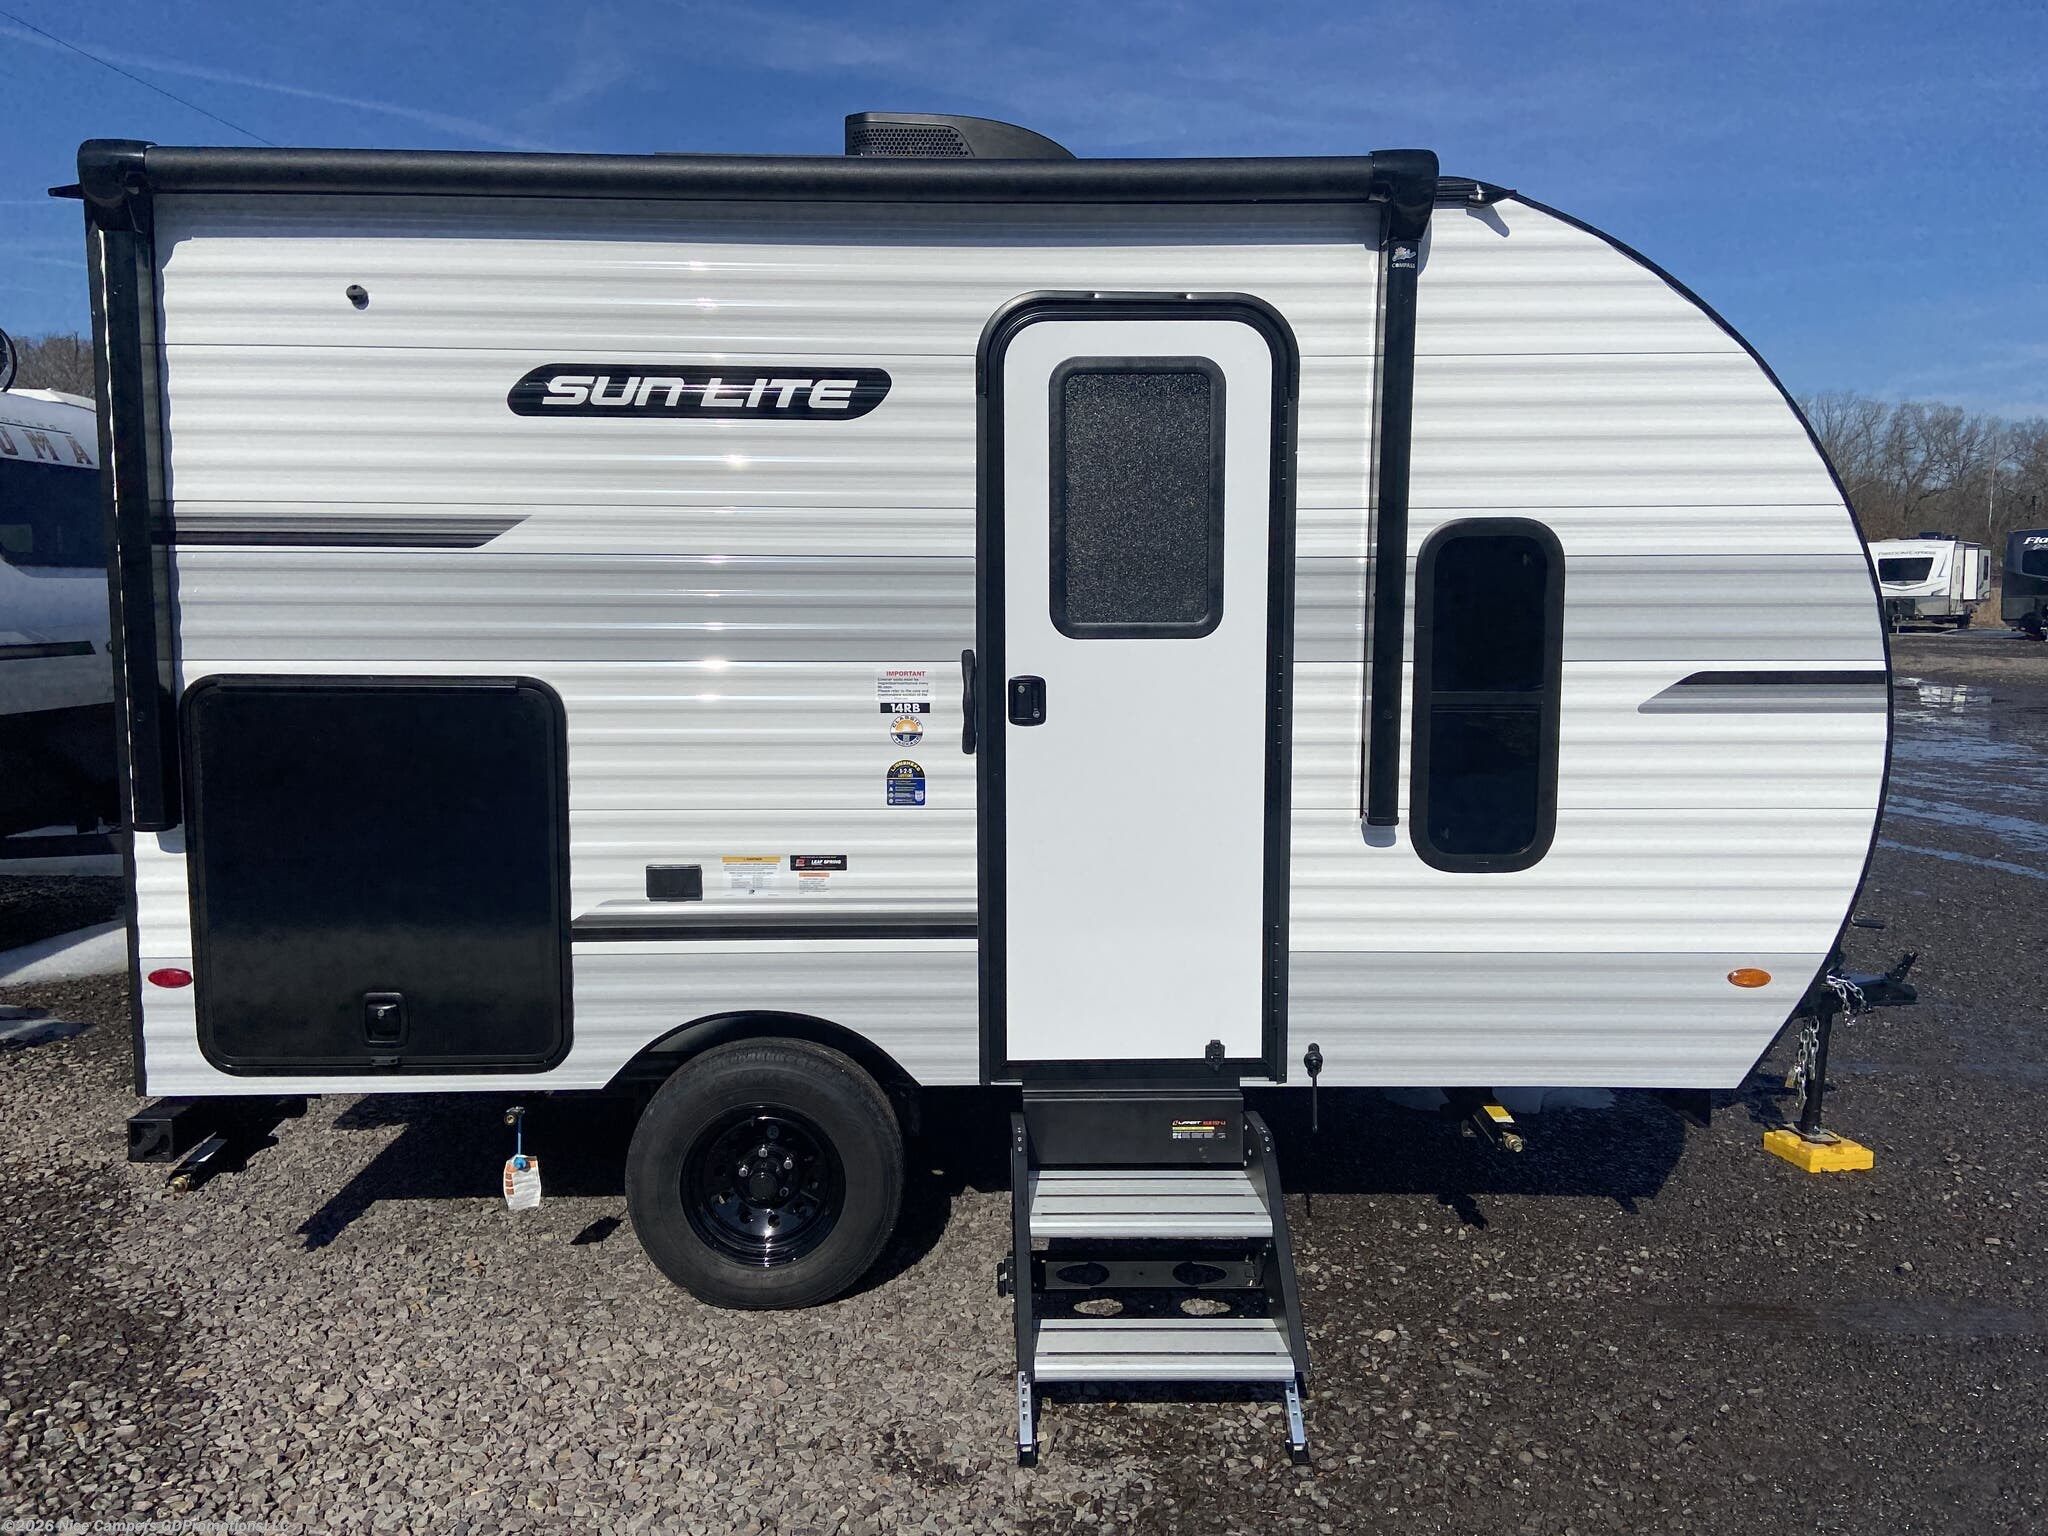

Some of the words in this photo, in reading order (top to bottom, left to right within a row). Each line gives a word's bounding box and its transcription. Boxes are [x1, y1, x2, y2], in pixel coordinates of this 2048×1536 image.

[542, 375, 685, 406] SUN
[700, 377, 858, 409] LITE
[890, 703, 921, 713] 14RB
